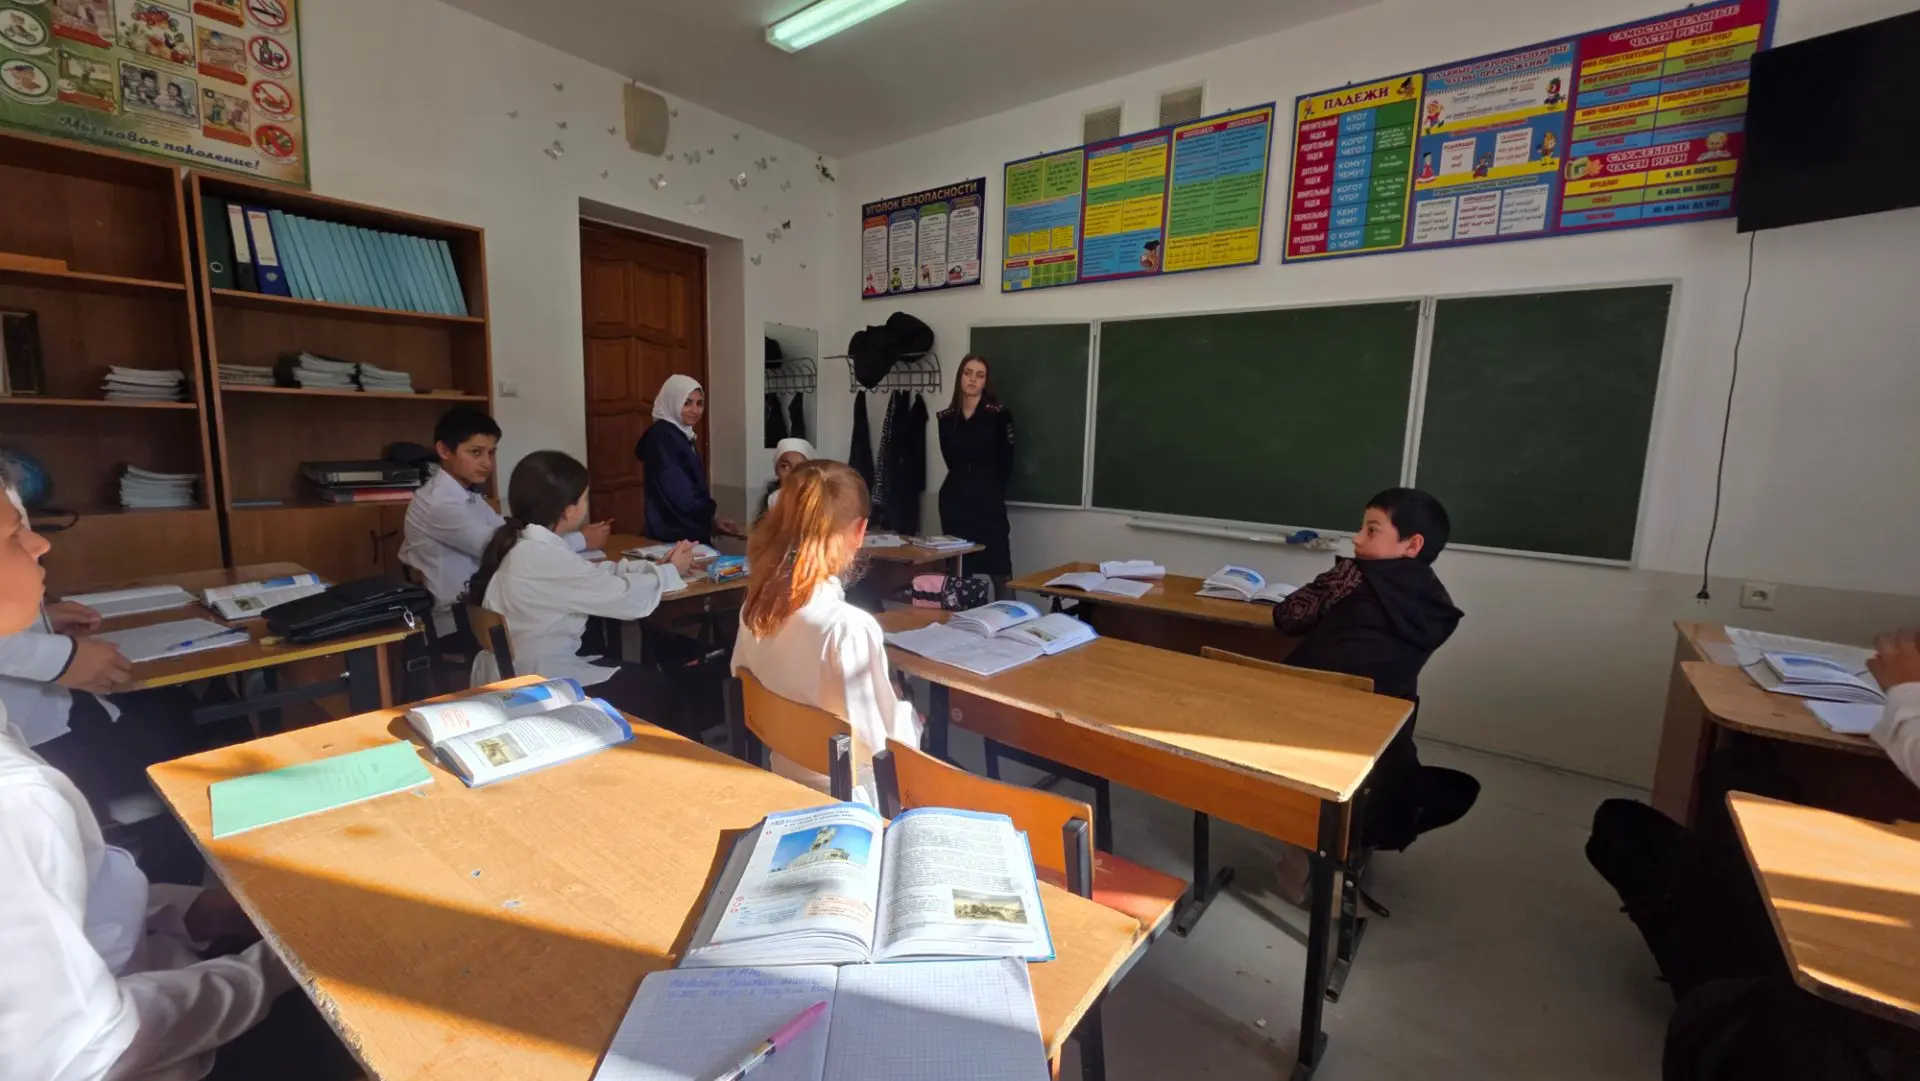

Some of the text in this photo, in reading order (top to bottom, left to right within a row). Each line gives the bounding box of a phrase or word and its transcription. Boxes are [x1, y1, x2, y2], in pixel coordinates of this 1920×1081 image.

[1608, 5, 1740, 41] САМОСТОЯТЕЛЬНЫЕ
[1629, 21, 1713, 47] ЧАСТИ РЕЧИ
[1323, 86, 1389, 110] ПАДЕЖИ
[1346, 112, 1367, 122] КТО?
[1345, 122, 1365, 133] ЧТО?
[1341, 135, 1367, 146] КОГО?
[103, 128, 160, 147] новое
[164, 142, 260, 170] поколение!
[1341, 146, 1366, 156] ЧЕГО?
[1606, 142, 1690, 163] СЛУЖЕБНЫЕ
[1338, 158, 1366, 169] КОМУ?
[1606, 152, 1687, 172] ЧАСТИ РЕЧИ
[1338, 168, 1364, 179] ЧЕМУ?
[1336, 183, 1363, 193] КОГО?
[866, 183, 976, 215] УГОЛОК БЕЗОПАСНОСТИ
[1338, 193, 1359, 202] ЧТО?
